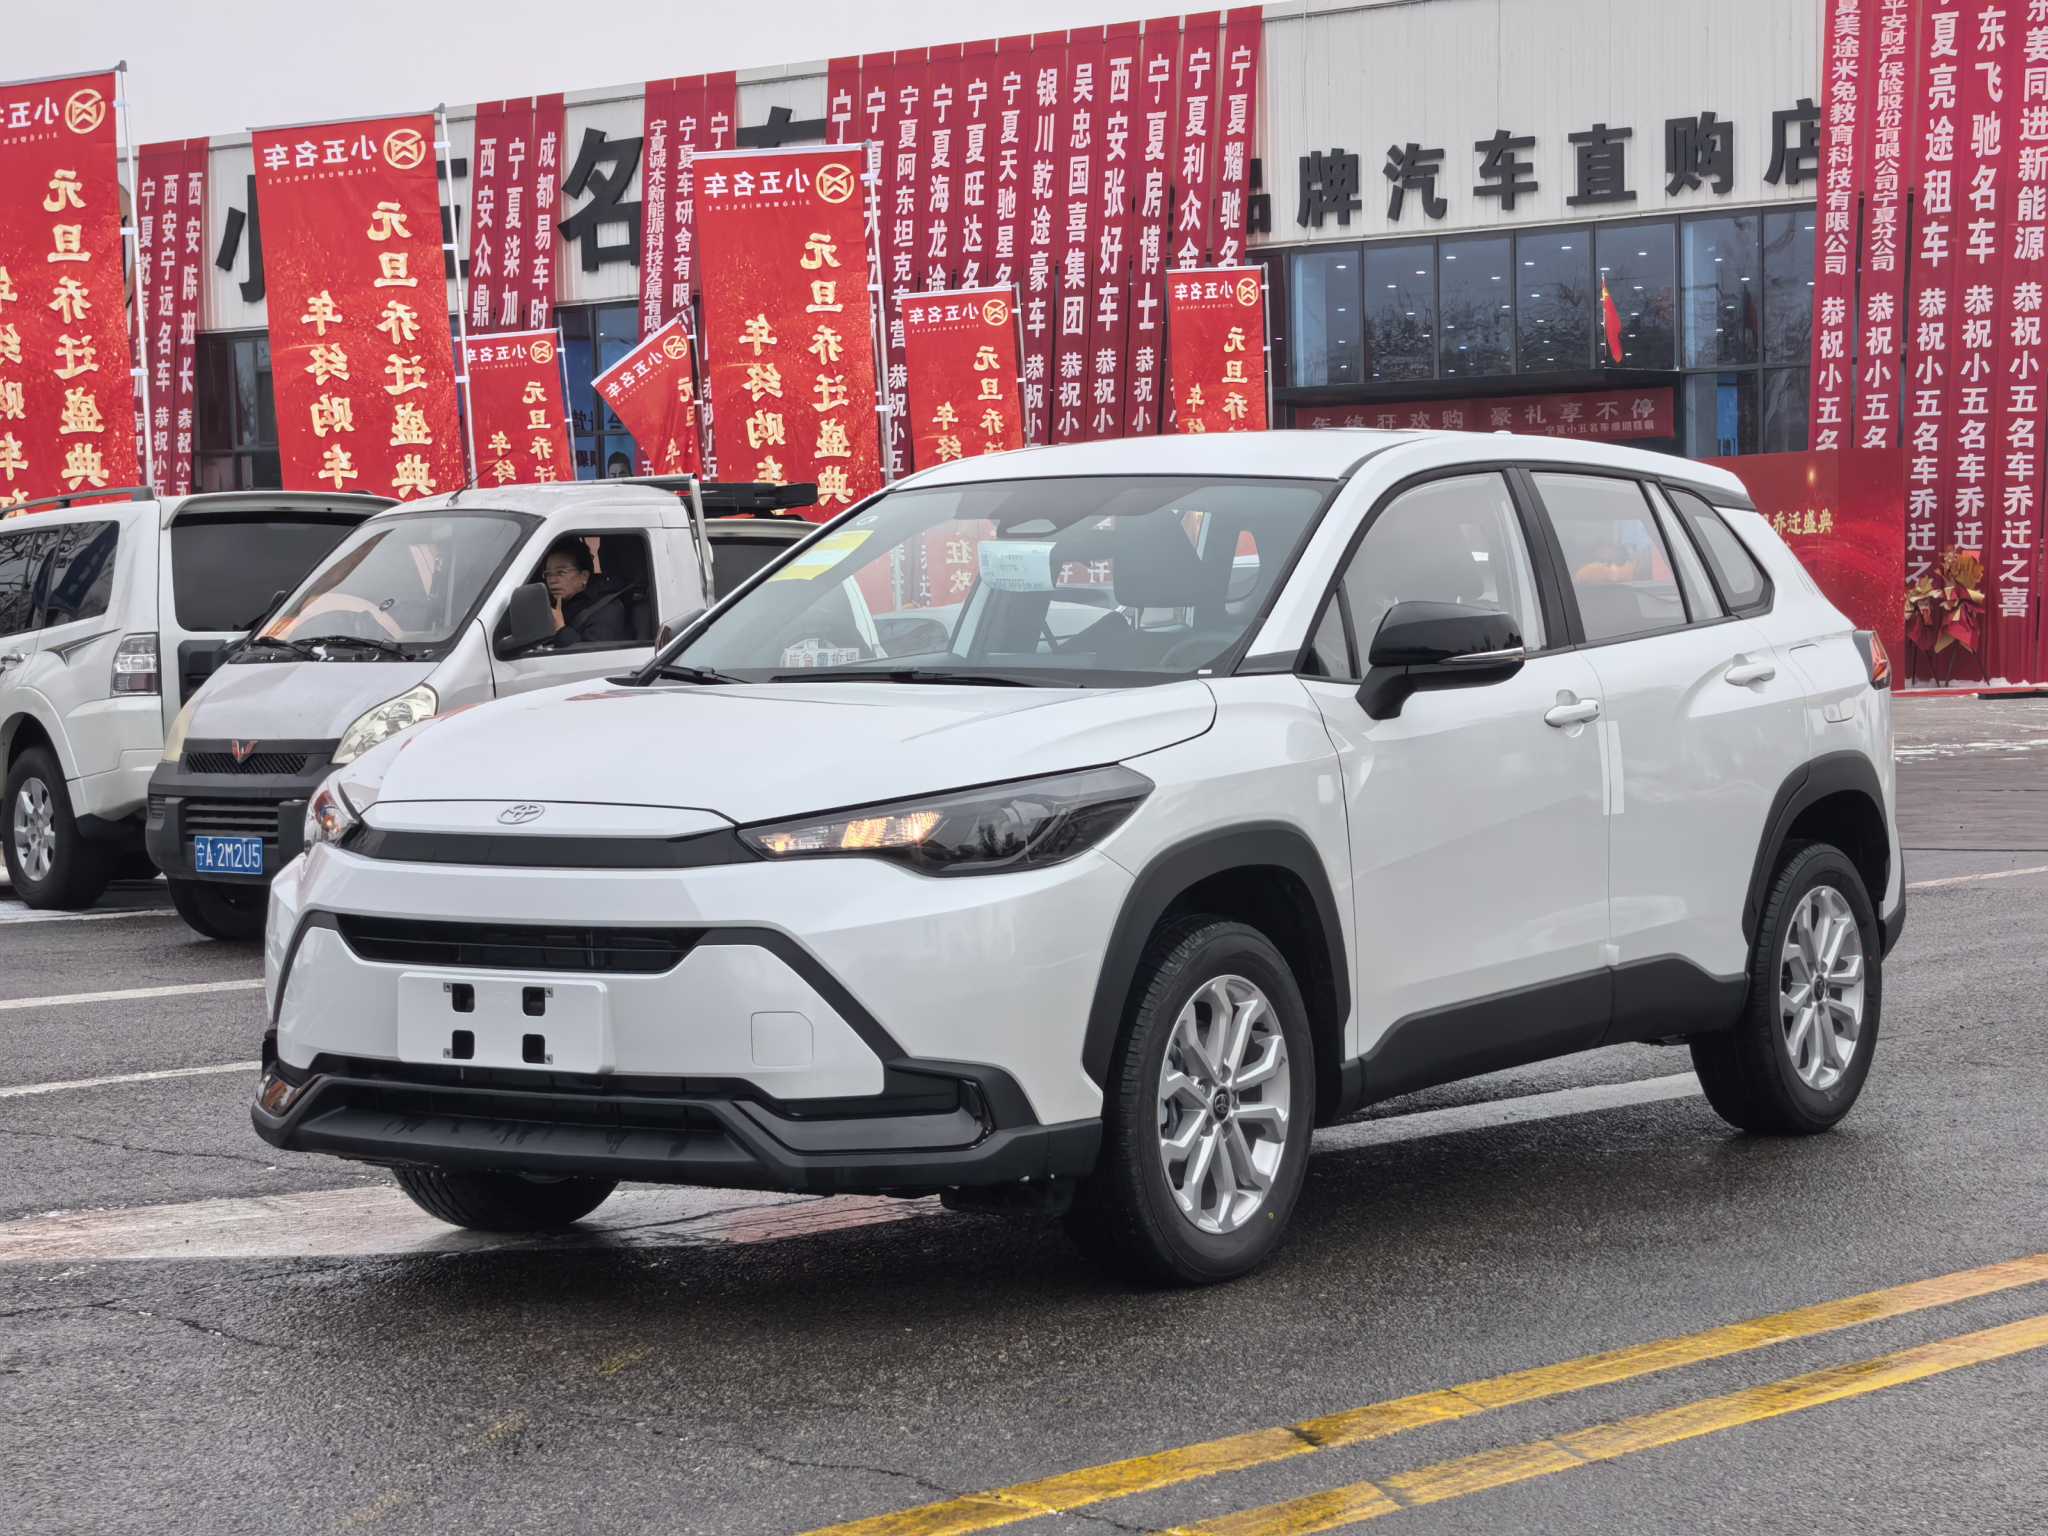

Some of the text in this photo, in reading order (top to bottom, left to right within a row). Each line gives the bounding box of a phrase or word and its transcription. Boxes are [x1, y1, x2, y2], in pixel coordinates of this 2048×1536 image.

[472, 137, 497, 327] 西安众鼎
[501, 136, 526, 326] 宁夏柒加
[530, 131, 557, 330] 成都易车时
[644, 119, 668, 335] 宁夏诚木新能源科技发展有限
[1027, 67, 1058, 338] 银川乾途豪车
[1058, 63, 1094, 436] 吴忠国喜集团 恭祝小
[1092, 56, 1132, 433] 西安张好车 恭祝小
[1132, 53, 1170, 432] 宁夏房博士 恭祝小
[1921, 0, 1960, 268] 夏亮途租车
[155, 174, 180, 393] 西安宁远名车
[888, 363, 909, 472] 恭祝小五
[1953, 284, 1994, 551] 恭祝小五名车乔迁
[1998, 281, 2044, 618] 恭祝小五名车乔迁之喜
